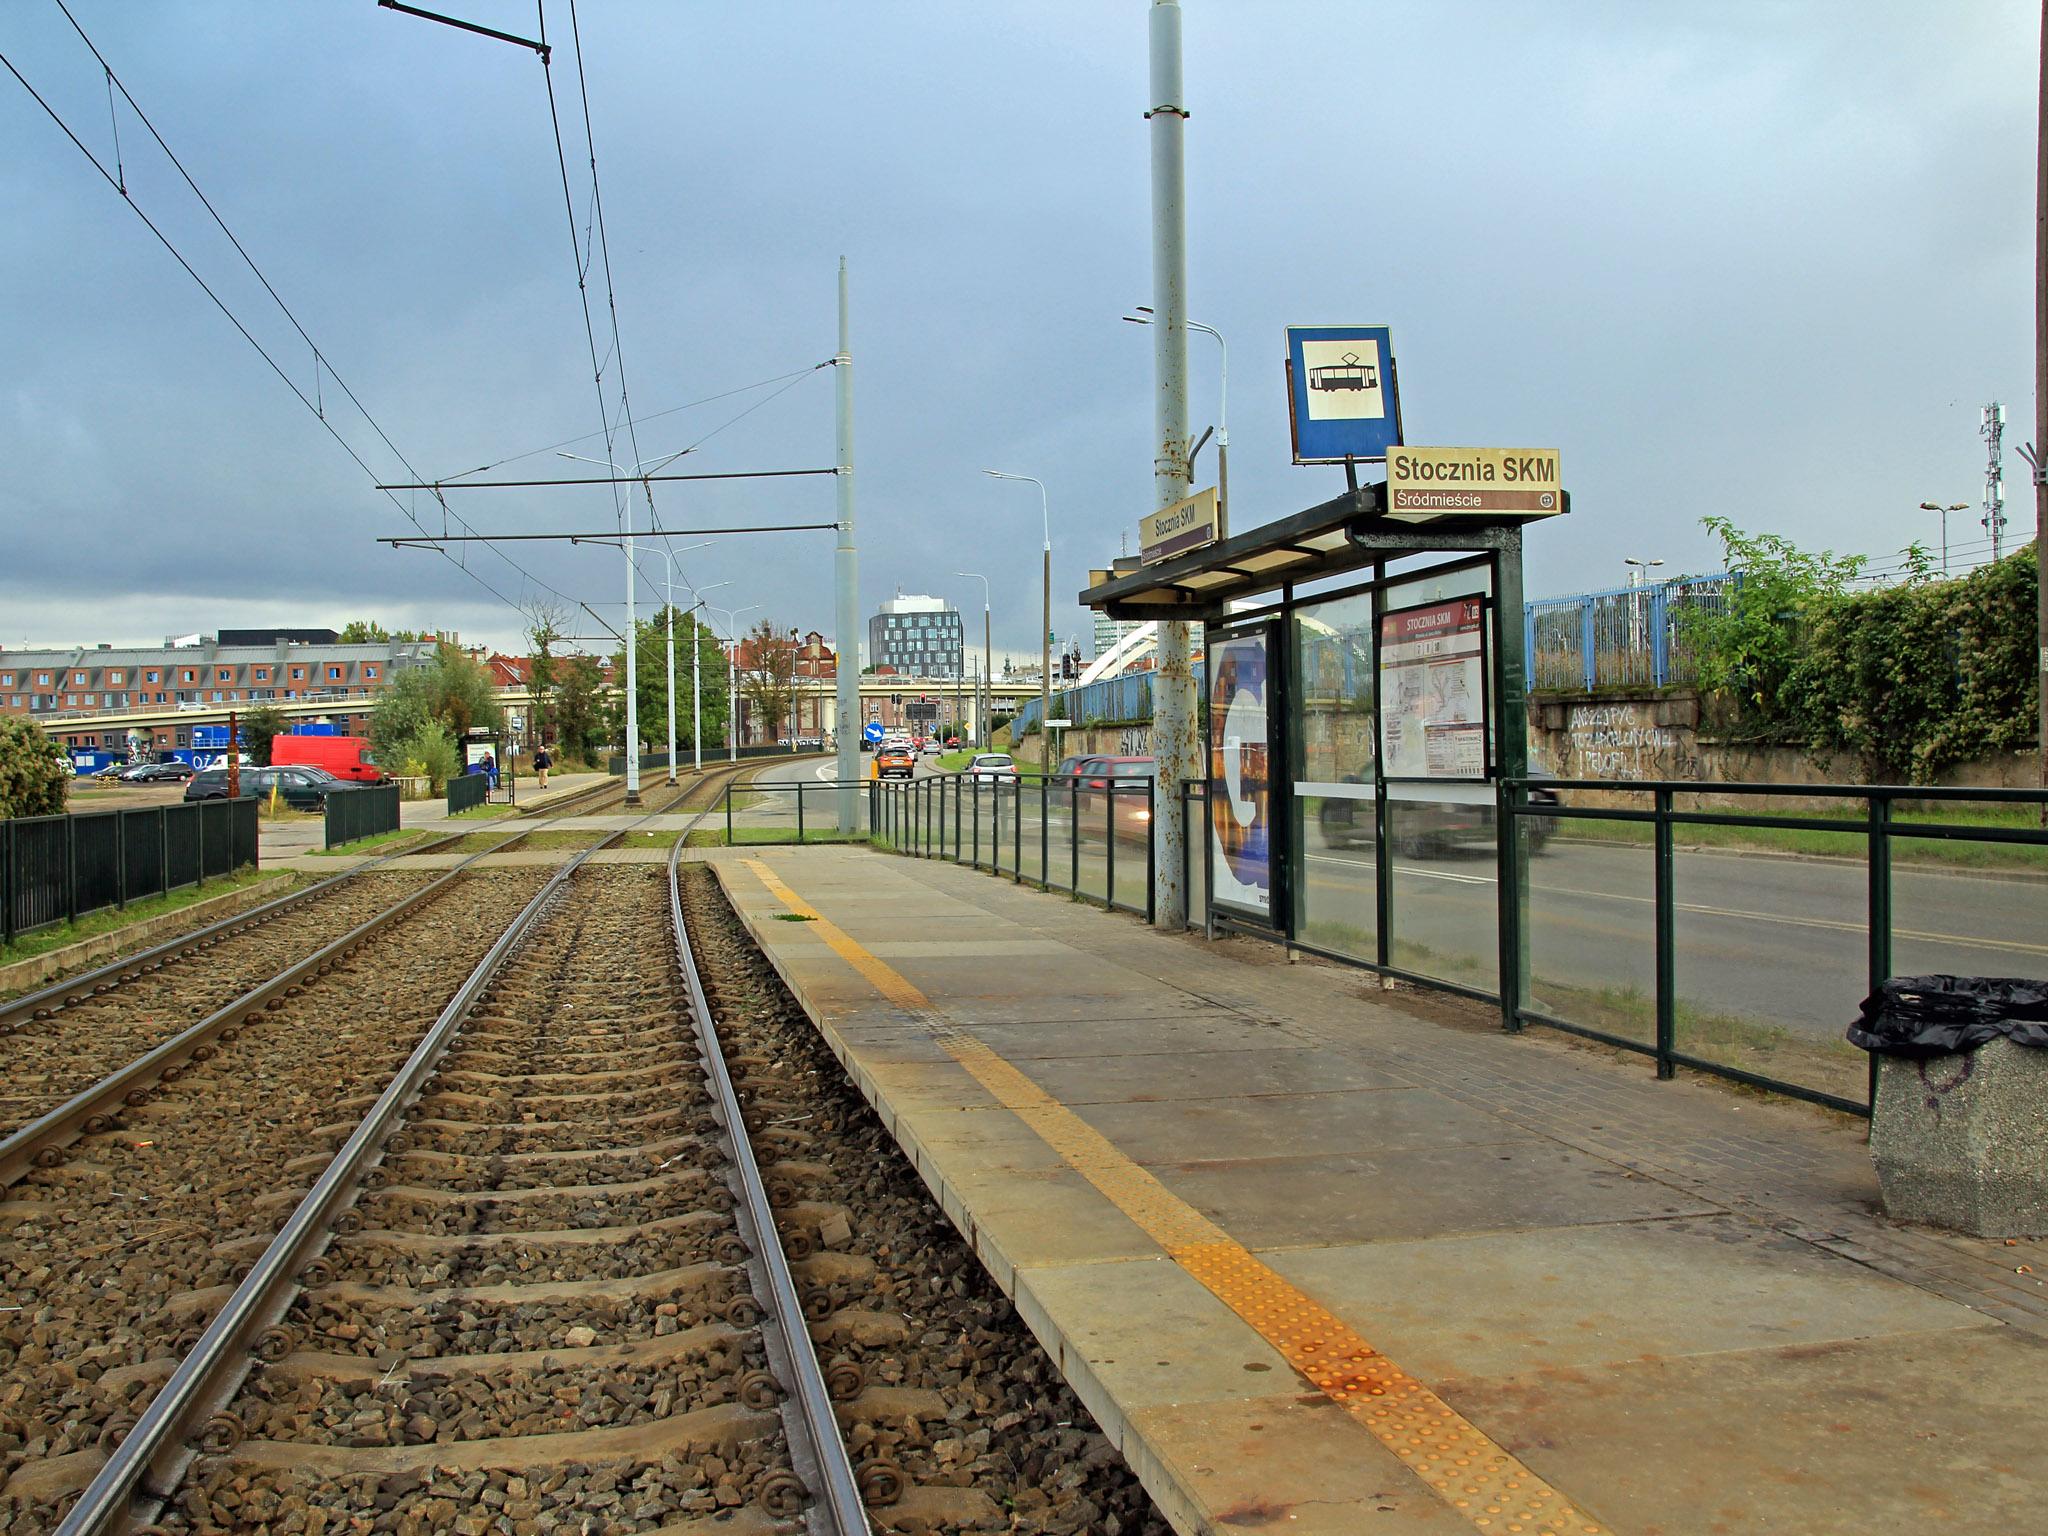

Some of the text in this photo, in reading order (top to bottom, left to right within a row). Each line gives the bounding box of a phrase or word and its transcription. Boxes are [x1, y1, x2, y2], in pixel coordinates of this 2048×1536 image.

[1395, 455, 1555, 482] Stocznia SKM
[1396, 490, 1482, 508] Śródmieście
[1155, 503, 1196, 537] Stocznia SKM
[1407, 612, 1451, 631] STOCZNIA SKM
